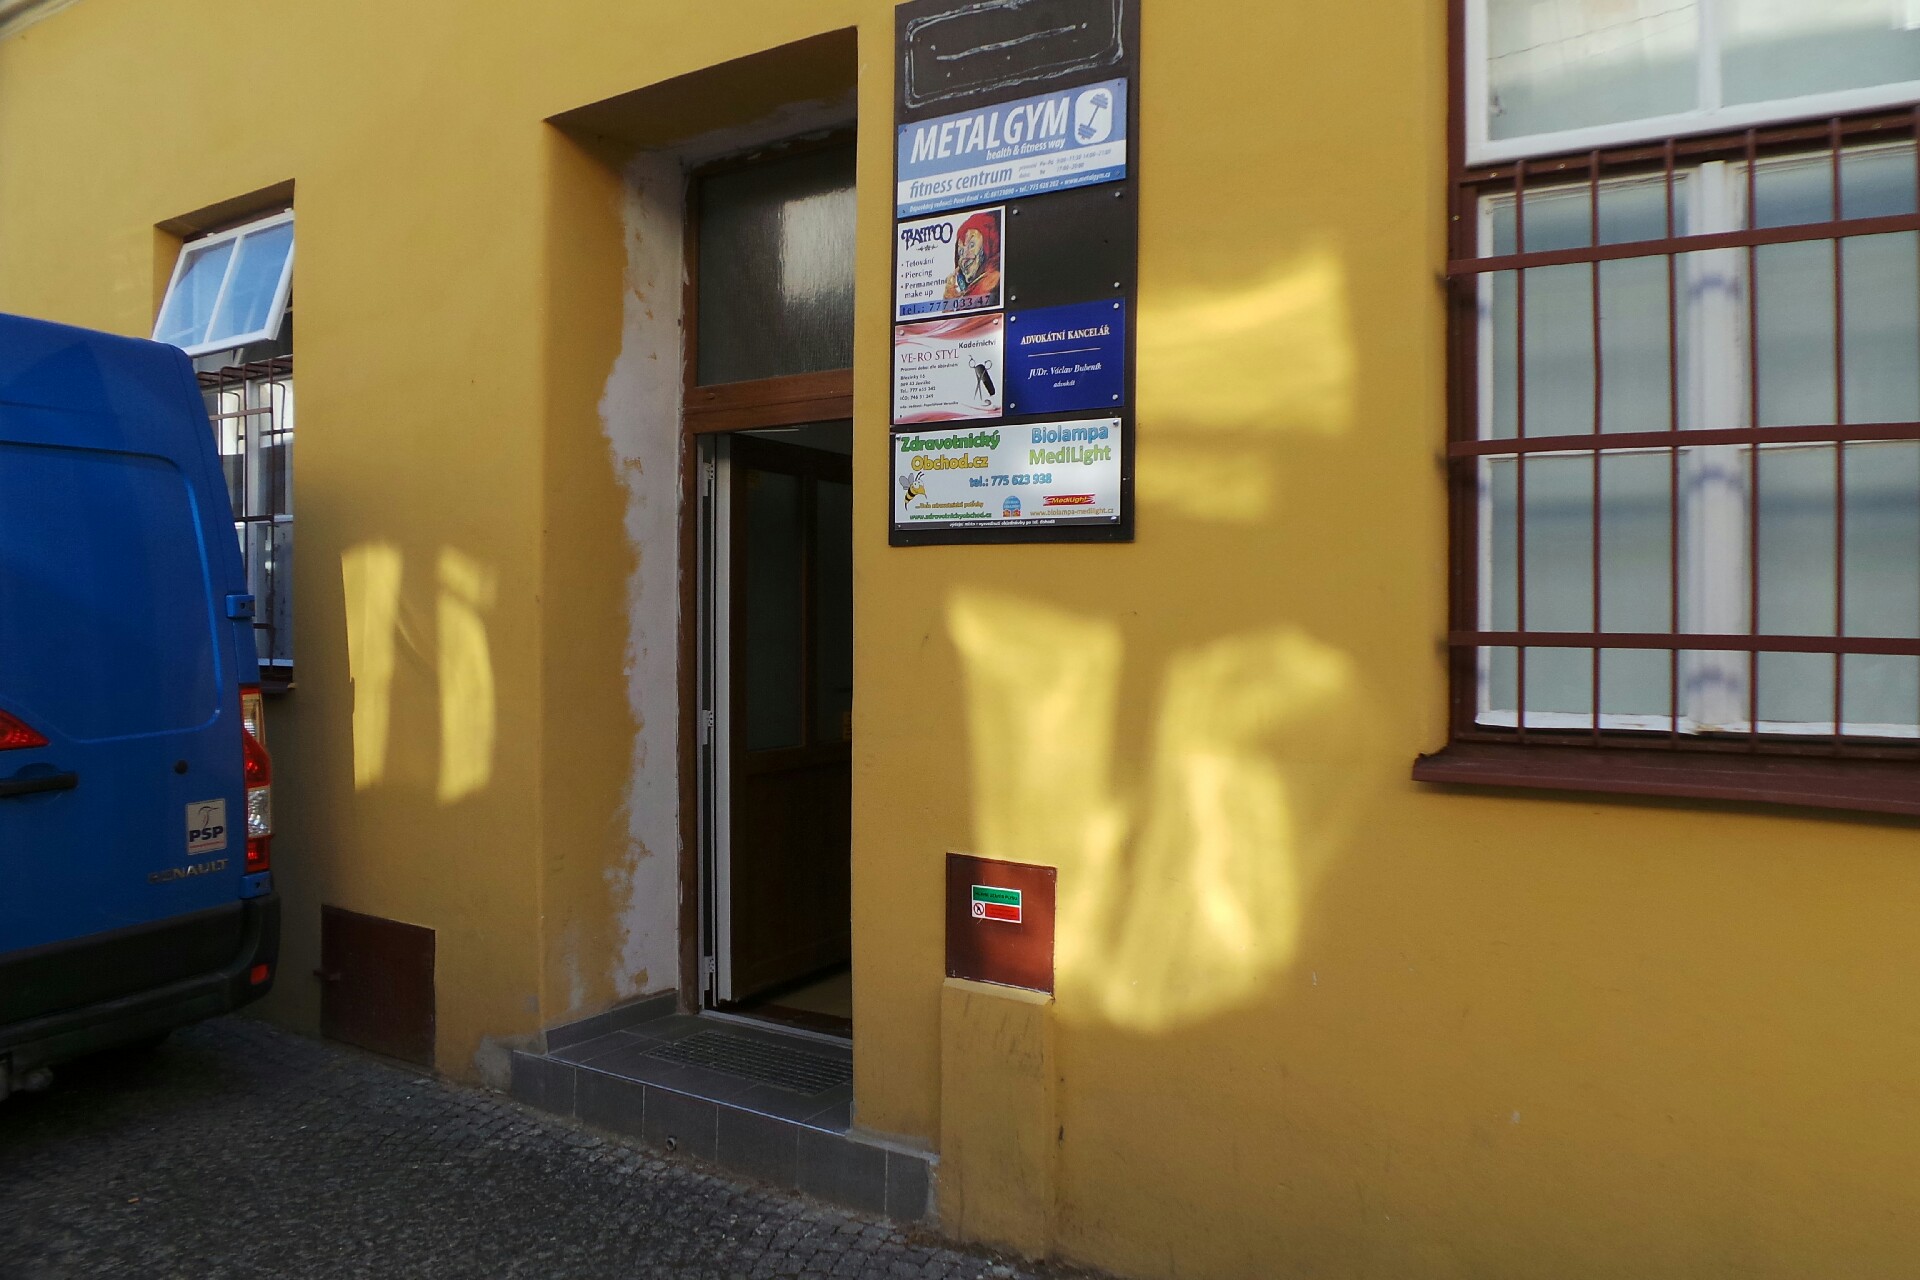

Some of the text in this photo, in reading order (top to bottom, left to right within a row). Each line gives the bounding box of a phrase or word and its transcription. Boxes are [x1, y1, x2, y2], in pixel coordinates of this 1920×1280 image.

[986, 136, 1065, 161] health & fitness way
[909, 178, 953, 199] fitness
[956, 167, 1013, 189] centrum
[901, 222, 953, 251] TATTOO
[905, 257, 935, 268] Tetování
[905, 269, 933, 279] Piercing
[904, 289, 934, 299] make up
[929, 300, 948, 311] 777
[953, 297, 973, 309] 033
[1020, 324, 1110, 345] ADVOKÁTNÍ KANCELÁŘ
[901, 348, 959, 363] VE-RO STYL
[1050, 365, 1073, 375] Václav
[901, 430, 1001, 453] Zdravotnický
[1031, 425, 1109, 444] Biolampa
[911, 453, 989, 472] Obchod.cz
[1029, 445, 1112, 466] MediLight
[969, 473, 1053, 488] tel.: 775 623 938
[1052, 496, 1088, 504] MediLight
[189, 825, 224, 843] PSP
